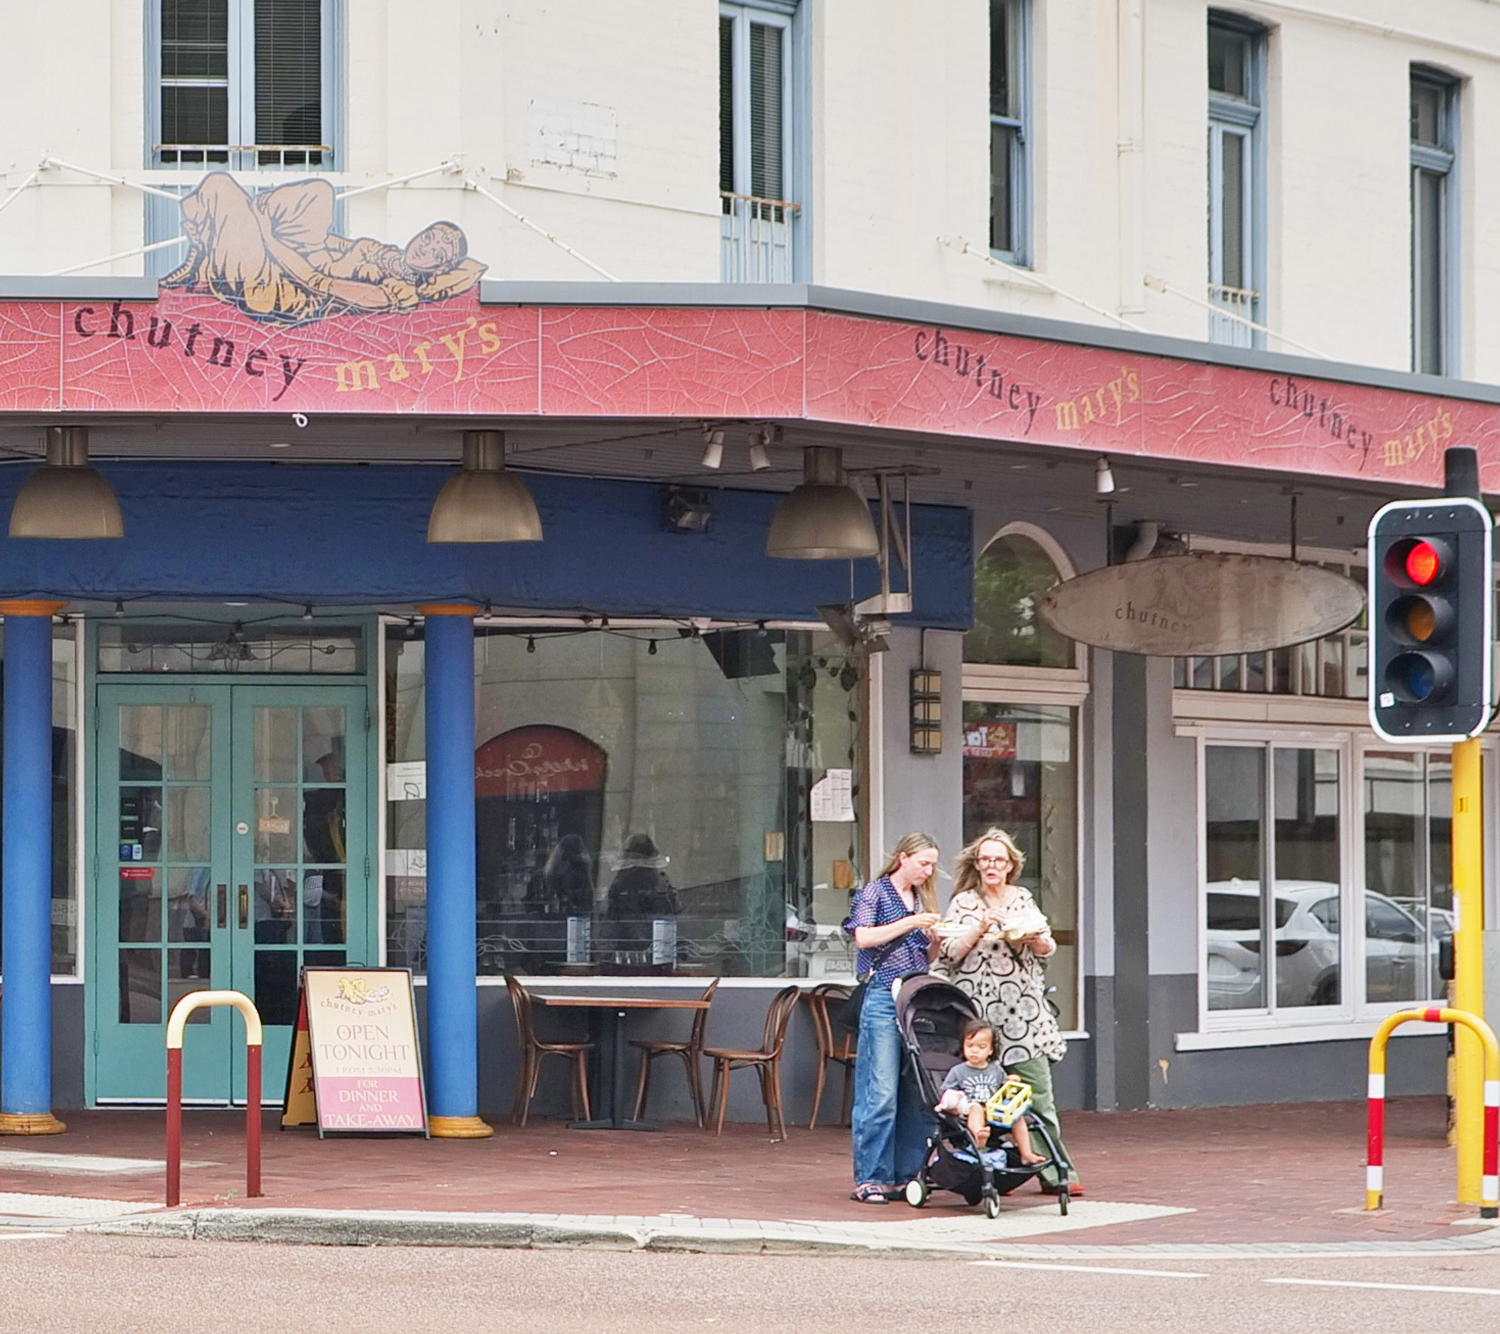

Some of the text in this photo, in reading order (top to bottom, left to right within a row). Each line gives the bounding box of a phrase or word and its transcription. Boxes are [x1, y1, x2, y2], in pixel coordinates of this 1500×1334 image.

[74, 300, 501, 402] chutney mary's
[914, 330, 1141, 436] chutney mary's
[1270, 376, 1454, 471] chutney mary's
[337, 1024, 389, 1040] OPEN
[320, 1043, 410, 1060] TONIGHT
[357, 1080, 378, 1088] FOR
[339, 1090, 399, 1103] DINNER
[359, 1104, 382, 1112] AND
[325, 1114, 415, 1127] TAKE-AWAY
